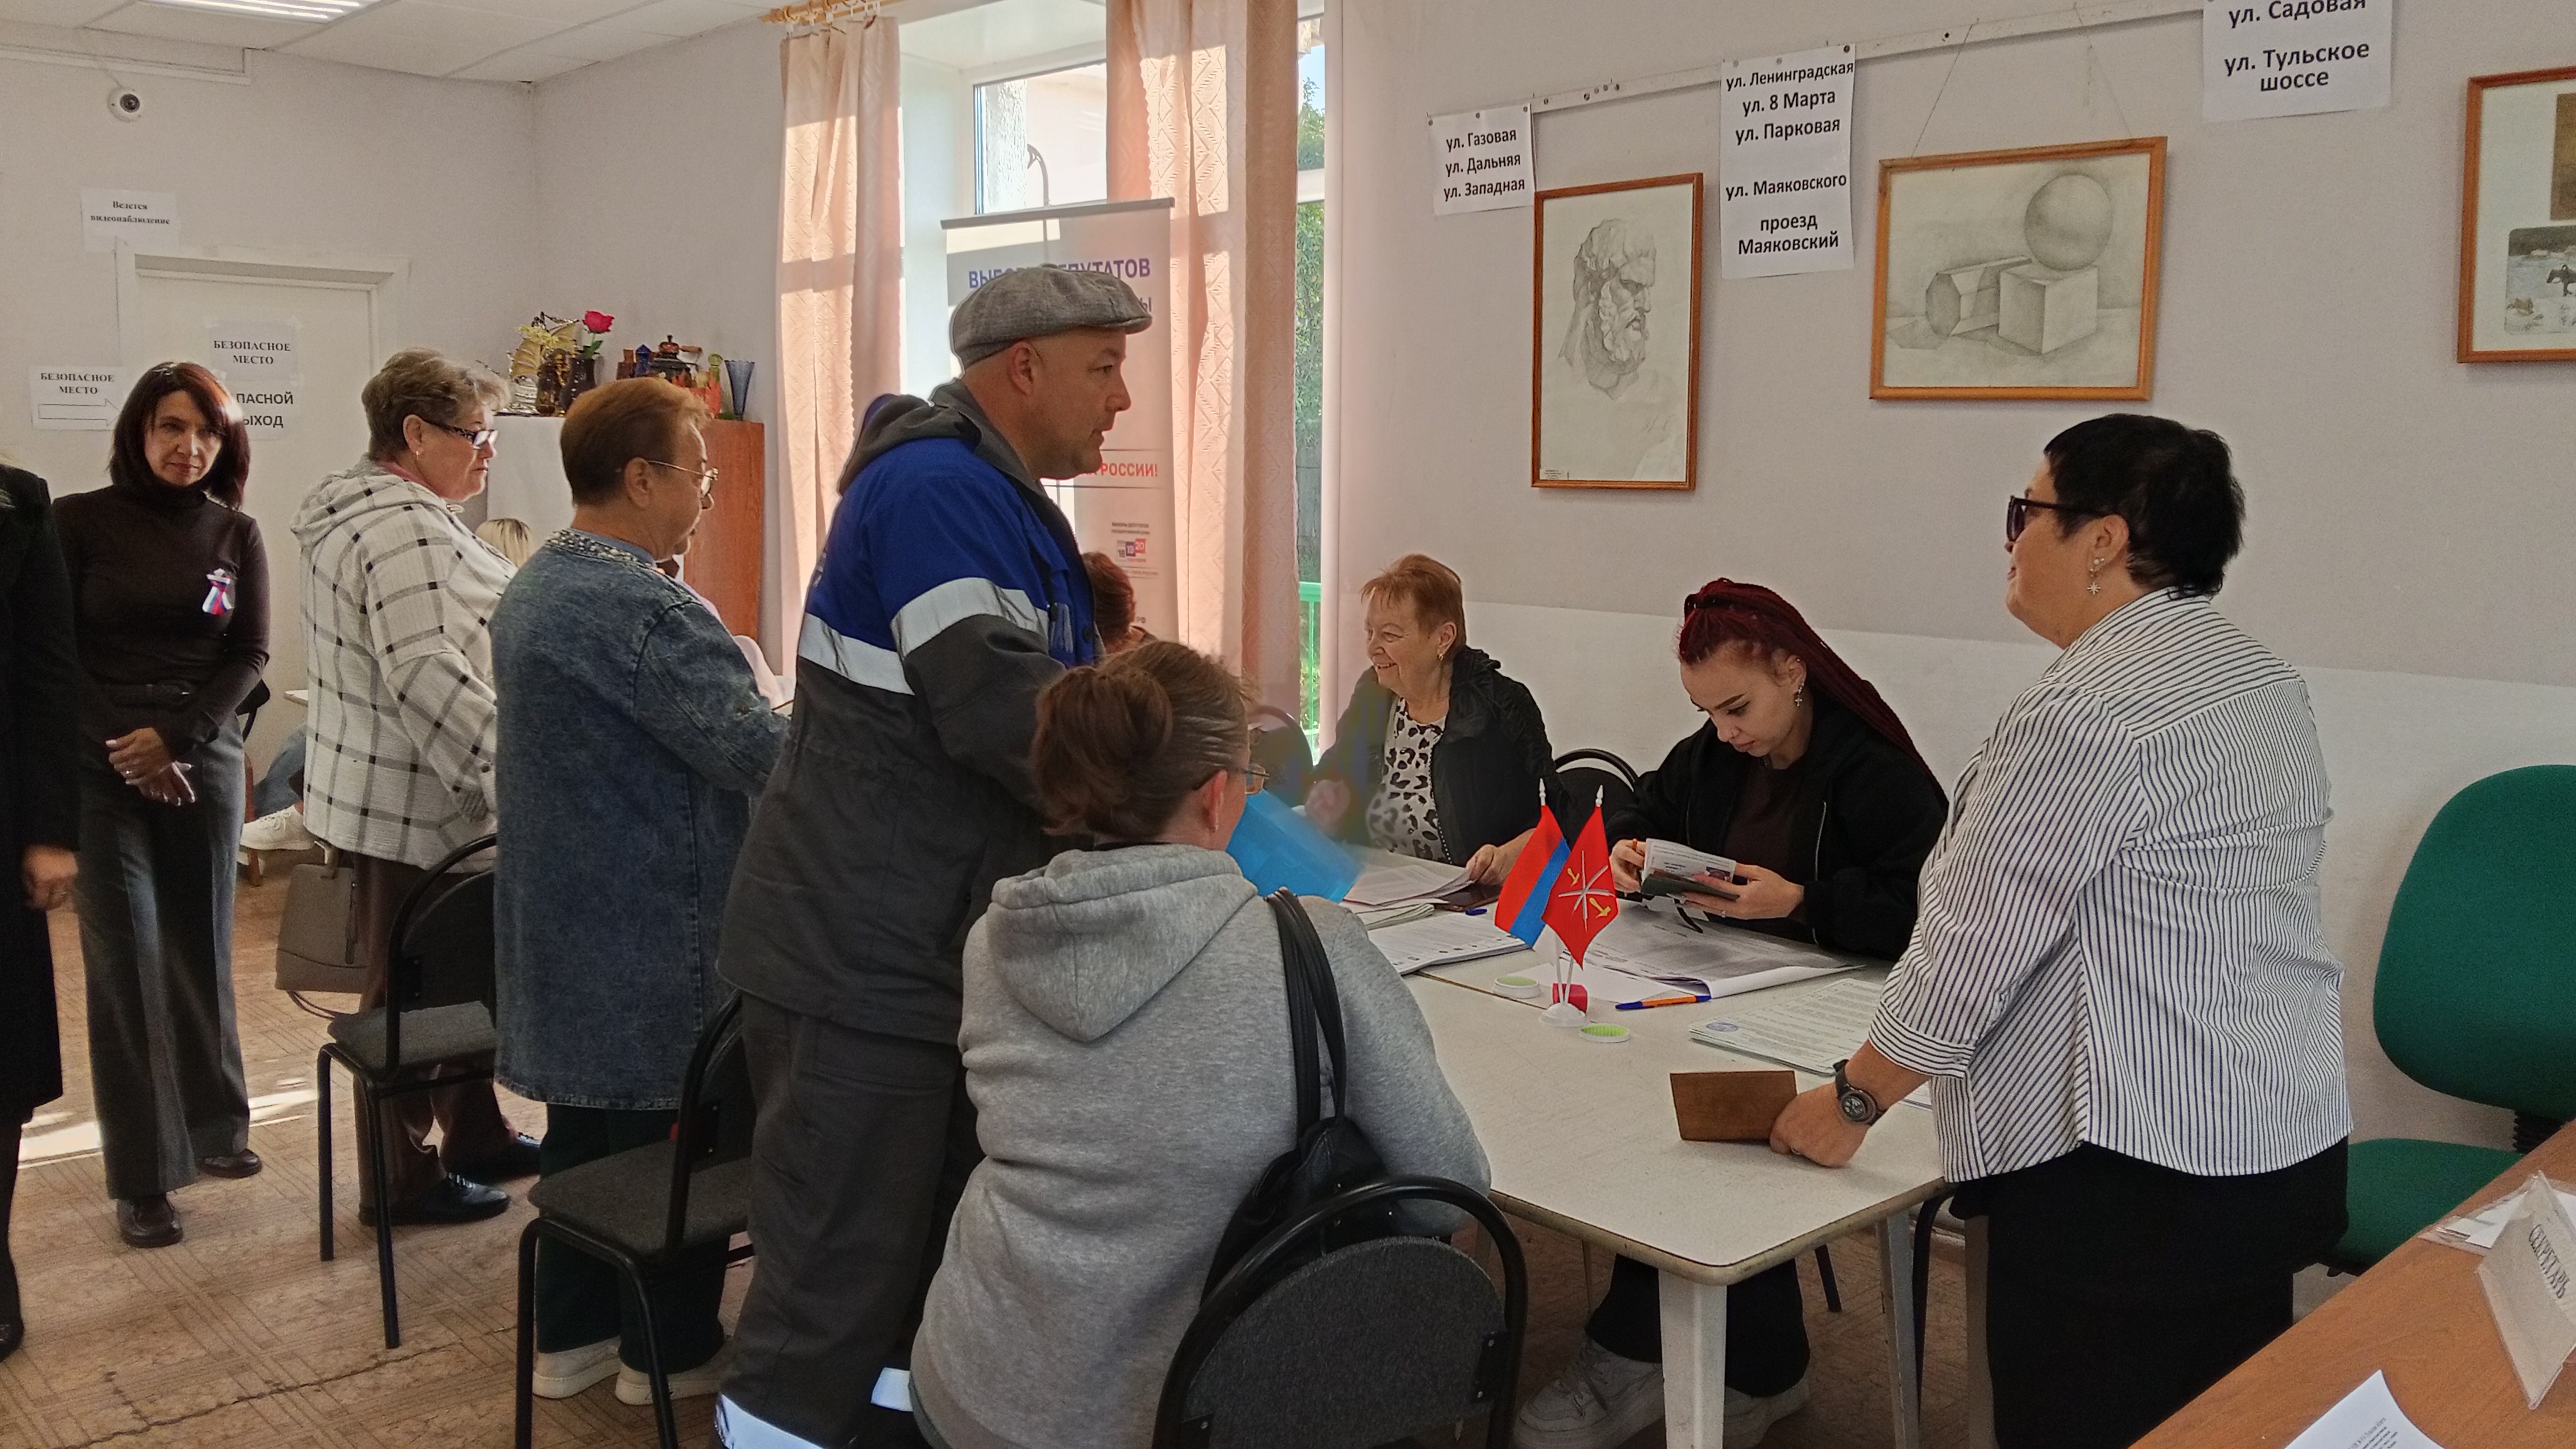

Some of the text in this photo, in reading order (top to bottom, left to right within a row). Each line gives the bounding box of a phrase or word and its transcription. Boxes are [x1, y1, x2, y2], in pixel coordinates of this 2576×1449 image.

[2229, 0, 2366, 28] ул. Садовая
[2224, 43, 2370, 77] ул. Тульское
[1726, 62, 1854, 92] ул. Ленинградская
[2260, 71, 2329, 92] шоссе
[1742, 91, 1835, 117] ул. 8 Марта
[1446, 130, 1517, 153] ул. Газовая
[1735, 119, 1840, 145] ул. Парковая
[1445, 154, 1521, 177] ул. Дальняя
[1443, 179, 1525, 202] ул. Западная
[1726, 174, 1847, 201] ул. Маяковского
[1760, 214, 1818, 234] проезд
[1738, 230, 1839, 255] Маяковский
[213, 340, 291, 352] БЕЗОПАСНОЕ
[233, 355, 274, 365] МЕСТО
[40, 372, 114, 382] БЕЗОПАСНОЕ
[59, 386, 98, 394] МЕСТО
[236, 391, 294, 404] ПАСНОЙ
[243, 415, 284, 428] ЫХОД
[1101, 462, 1158, 477] РОССИИ!
[1135, 541, 1145, 550] 20
[2528, 1223, 2570, 1299] СЕКРЕТАРЬ
